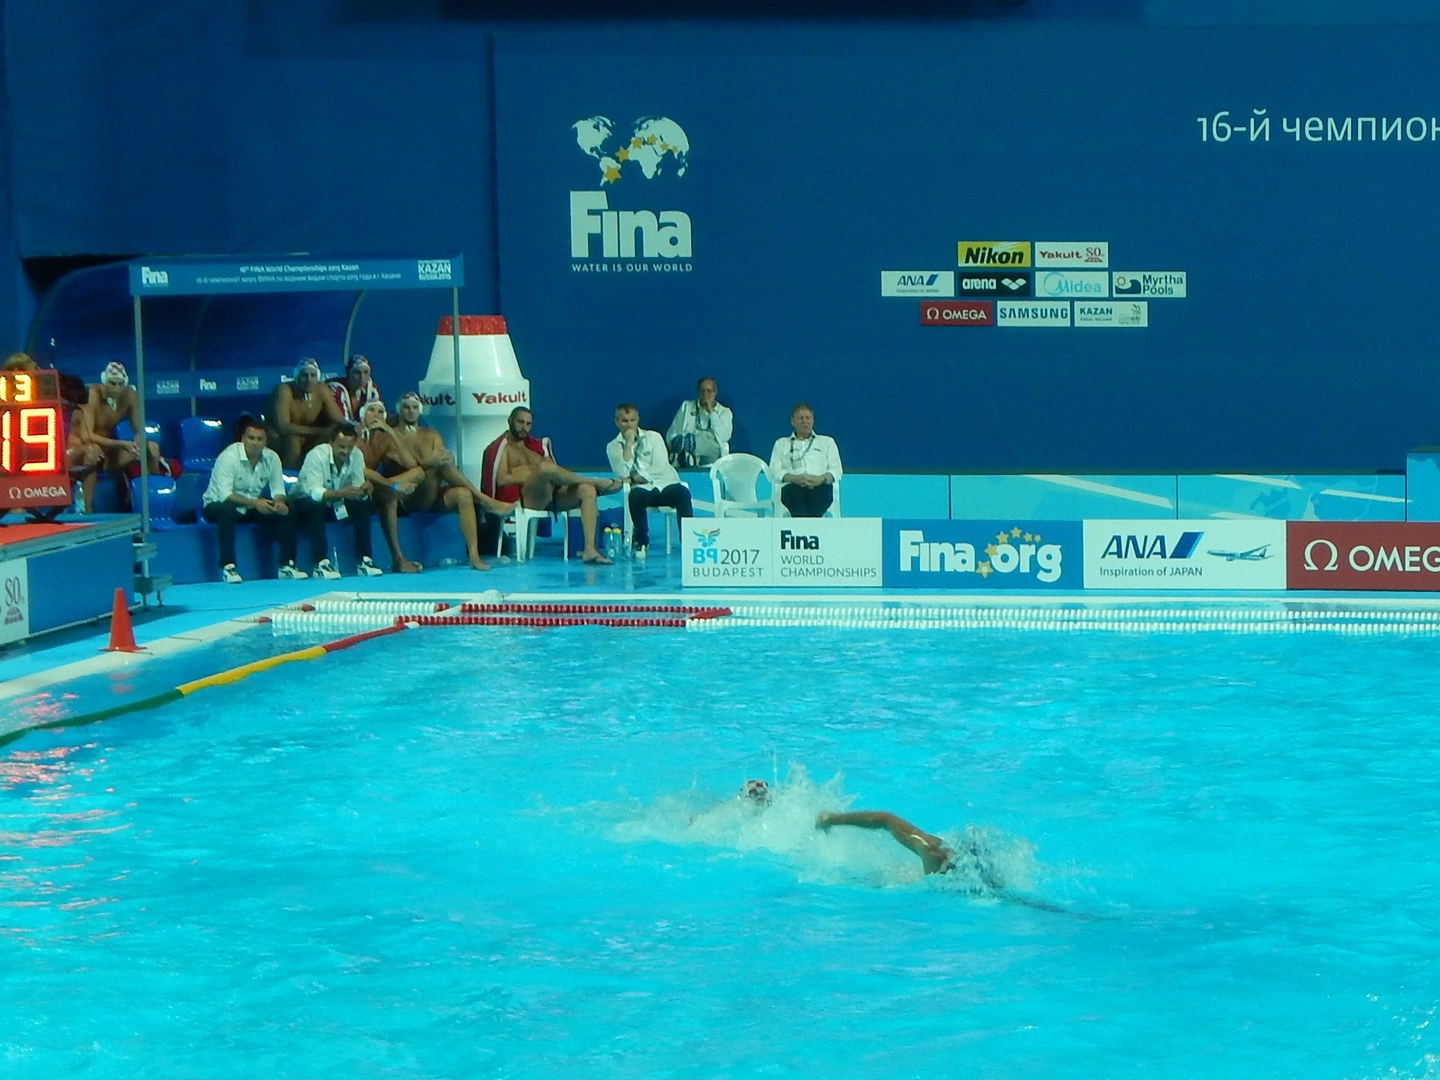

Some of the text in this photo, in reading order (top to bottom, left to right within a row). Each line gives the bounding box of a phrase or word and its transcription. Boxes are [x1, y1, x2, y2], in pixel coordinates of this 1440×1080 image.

[1198, 109, 1269, 141] 16-й
[570, 191, 692, 258] Fina
[964, 247, 1024, 265] Nikon
[418, 263, 451, 273] KAZAN
[572, 264, 608, 272] WATER
[613, 264, 622, 272] IS
[626, 264, 648, 272] OUR
[142, 266, 169, 284] Fina
[898, 276, 924, 285] ANA
[1142, 274, 1183, 288] Myrtha
[963, 279, 996, 289] arena
[1054, 278, 1101, 293] Midea
[1142, 285, 1174, 295] Pools
[943, 310, 987, 319] OMEGA
[1000, 308, 1068, 319] SAMSUNG
[472, 391, 527, 404] Yakult
[2, 408, 56, 471] 19
[23, 486, 67, 498] OMEGA
[781, 530, 819, 550] Fina
[1101, 535, 1166, 559] ANA
[721, 549, 759, 564] 2017
[781, 554, 824, 565] WORLD
[693, 568, 763, 577] BUDAPEST
[780, 567, 877, 578] CHAMPIONSHIPS
[1100, 567, 1202, 577] Inspiration of JAPAN
